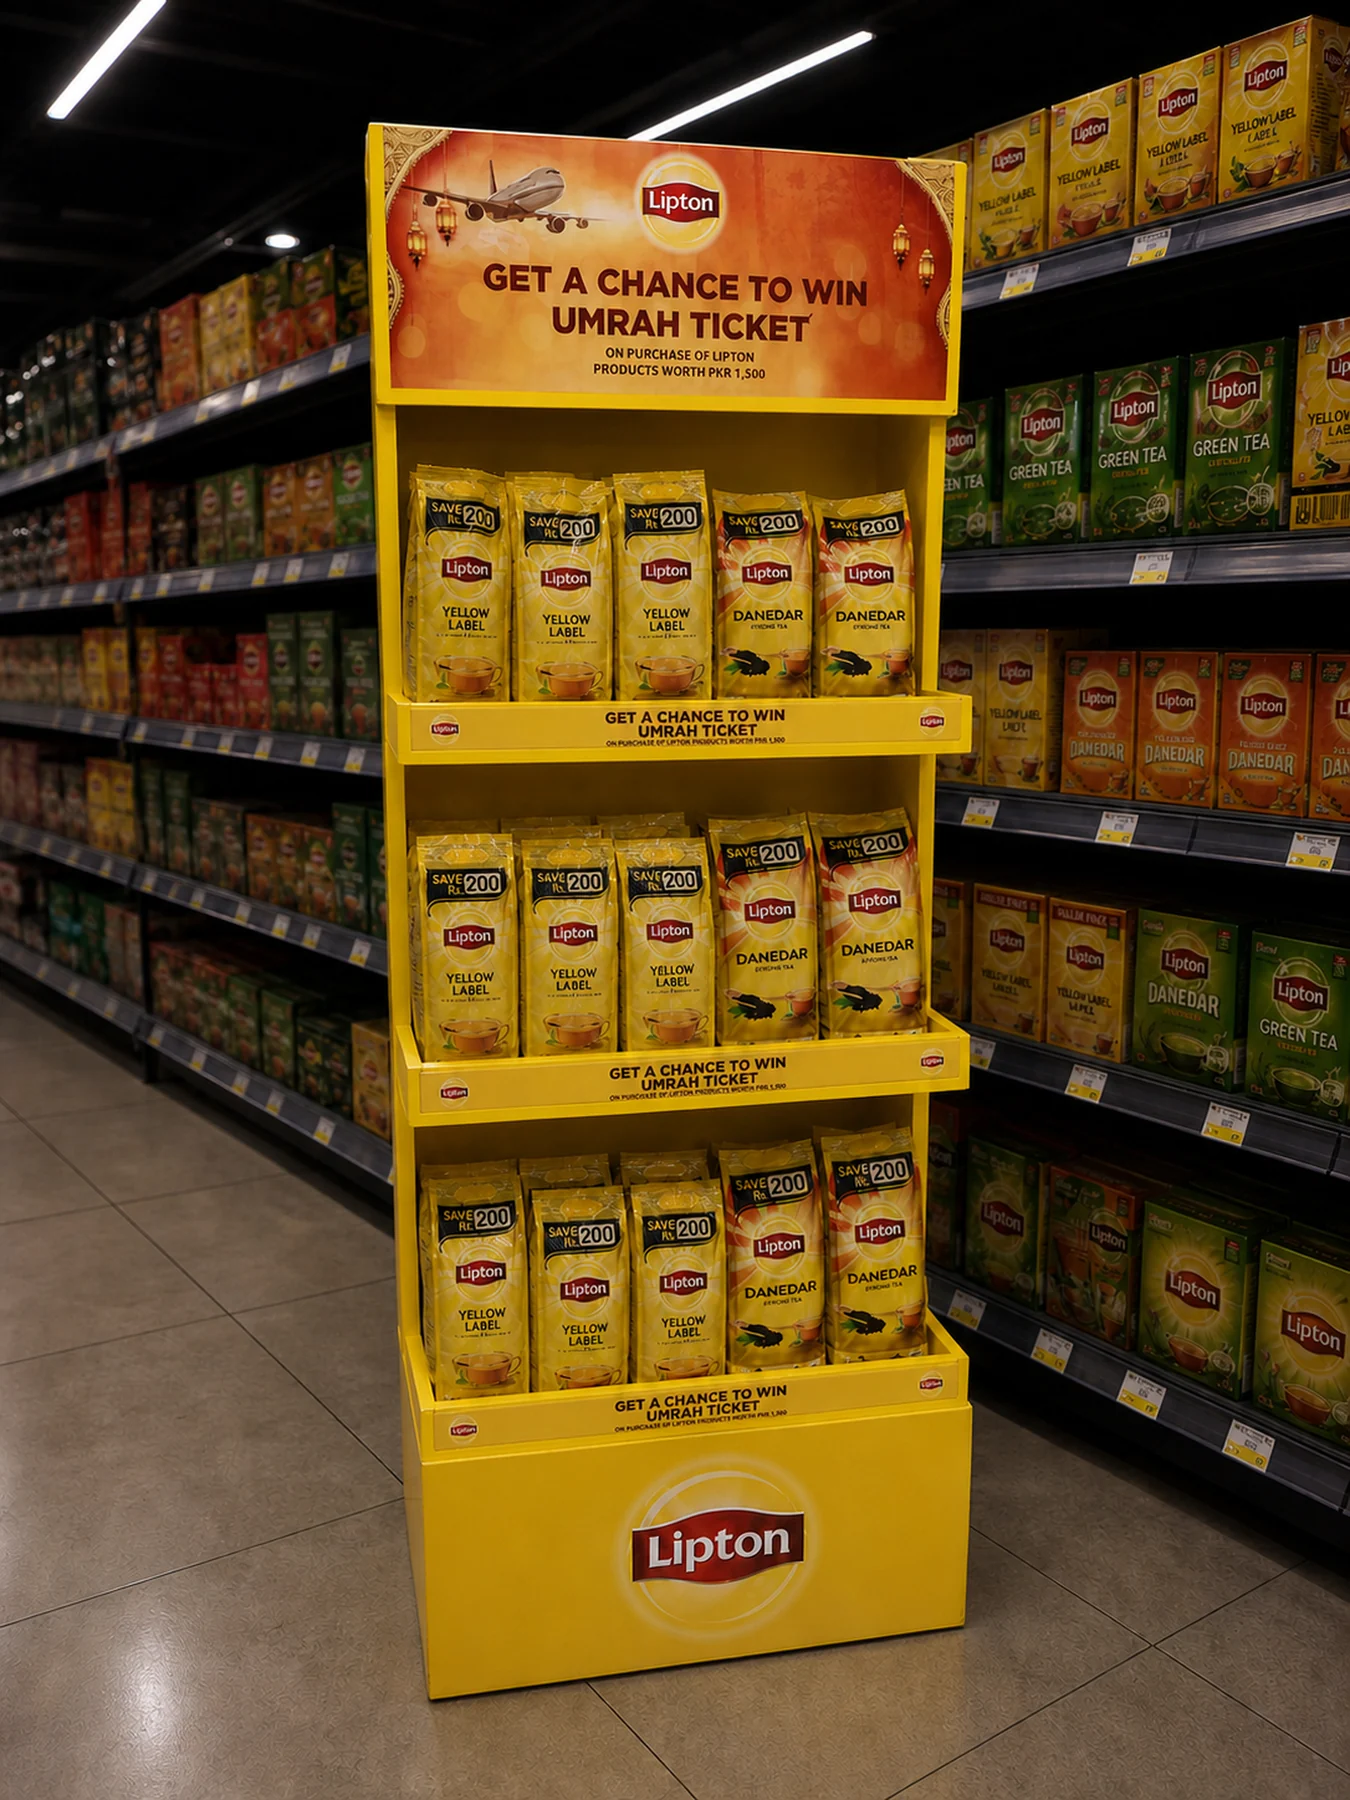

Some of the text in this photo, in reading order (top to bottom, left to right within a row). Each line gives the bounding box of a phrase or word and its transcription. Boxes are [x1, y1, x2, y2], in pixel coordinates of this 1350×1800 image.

[1247, 65, 1284, 87] Lipton
[1161, 93, 1196, 112] Lipton
[1074, 121, 1107, 141] Lipton
[1231, 116, 1269, 135] YELLOW
[1146, 142, 1182, 159] YELLOW
[1057, 168, 1095, 186] YELLOW
[648, 190, 714, 214] Lipton
[483, 263, 868, 306] GET A CHANCE TO WIN
[552, 306, 812, 343] UMRAH TICKET
[605, 346, 755, 364] ON PURCHASE OF LIPTON
[593, 363, 766, 381] PRODUCTS WORTH PKR 1,500
[1212, 378, 1257, 402] Lipton
[1113, 399, 1155, 421] Lipton
[1023, 413, 1060, 435] Lipton
[1192, 433, 1270, 458] GREEN TEA
[1098, 446, 1167, 469] GREEN TEA
[1009, 460, 1073, 481] GREEN TEA
[964, 474, 985, 489] TEA
[431, 501, 462, 515] SAVE
[465, 507, 494, 529] 200
[661, 507, 696, 527] 200
[761, 515, 797, 532] 200
[562, 520, 595, 538] 200
[863, 518, 897, 535] 200
[446, 561, 489, 578] Lipton
[645, 563, 688, 580] Lipton
[746, 567, 788, 581] Lipton
[849, 568, 891, 583] Lipton
[545, 571, 588, 588] Lipton
[442, 606, 490, 619] YELLOW
[542, 614, 591, 625] YELLOW
[643, 608, 691, 619] YELLOW
[733, 610, 803, 622] DANEDAR
[835, 610, 906, 622] DANEDAR
[448, 620, 485, 631] LABEL
[549, 626, 586, 638] LABEL
[650, 620, 685, 632] LABEL
[1083, 692, 1115, 707] Lipton
[1159, 694, 1194, 709] Lipton
[1245, 699, 1283, 716] Lipton
[605, 709, 785, 724] GET A CHANCE TO WIN
[638, 723, 758, 738] UMRAH TICKET
[1070, 740, 1125, 762] DANEDAR
[1145, 744, 1205, 767] DANEDAR
[1228, 750, 1295, 775] DANEDAR
[864, 834, 900, 853] 200
[727, 847, 758, 859] SAVE
[762, 843, 797, 863] 200
[432, 874, 463, 885] SAVE
[466, 875, 500, 892] 200
[537, 872, 565, 884] SAVE
[570, 873, 602, 890] 200
[665, 872, 696, 889] 200
[853, 893, 898, 911] Lipton
[749, 904, 792, 920] Lipton
[448, 930, 491, 945] Lipton
[553, 927, 594, 943] Lipton
[651, 924, 690, 940] Lipton
[842, 938, 914, 957] DANEDAR
[736, 948, 808, 965] DANEDAR
[1069, 950, 1102, 966] Lipton
[1165, 953, 1206, 977] Lipton
[446, 972, 494, 984] YELLOW
[550, 967, 597, 979] YELLOW
[650, 964, 695, 976] YELLOW
[452, 984, 490, 996] LABEL
[556, 980, 592, 991] LABEL
[656, 977, 690, 988] LABEL
[1148, 981, 1220, 1018] DANEDAR
[1277, 979, 1324, 1005] Lipton
[1259, 1018, 1339, 1051] GREEN TEA
[609, 1056, 787, 1080] GET A CHANCE TO WIN
[641, 1075, 700, 1092] UMRAH
[703, 1072, 758, 1089] TICKET
[838, 1164, 869, 1178] SAVE
[872, 1161, 906, 1181] 200
[735, 1178, 767, 1190] SAVE
[770, 1174, 805, 1195] 200
[443, 1210, 474, 1221] SAVE
[476, 1207, 510, 1228] 200
[982, 1204, 1022, 1232] Lipton
[548, 1227, 578, 1239] SAVE
[647, 1219, 675, 1231] SAVE
[678, 1218, 711, 1237] 200
[859, 1223, 902, 1240] Lipton
[580, 1226, 614, 1244] 200
[1090, 1223, 1126, 1251] Lipton
[757, 1238, 801, 1254] Lipton
[460, 1264, 503, 1281] Lipton
[847, 1265, 918, 1285] DANEDAR
[564, 1283, 606, 1298] Lipton
[664, 1276, 704, 1291] Lipton
[745, 1280, 817, 1299] DANEDAR
[1169, 1274, 1218, 1305] Lipton
[458, 1307, 507, 1320] YELLOW
[661, 1315, 706, 1328] YELLOW
[465, 1320, 501, 1331] LABEL
[562, 1322, 608, 1335] YELLOW
[667, 1327, 701, 1338] LABEL
[1286, 1314, 1341, 1350] Lipton
[568, 1335, 604, 1346] LABEL
[615, 1384, 788, 1412] GET A CHANCE TO WIN
[646, 1404, 702, 1423] UMRAH
[706, 1400, 760, 1418] TICKET
[648, 1526, 790, 1573] Lipton
